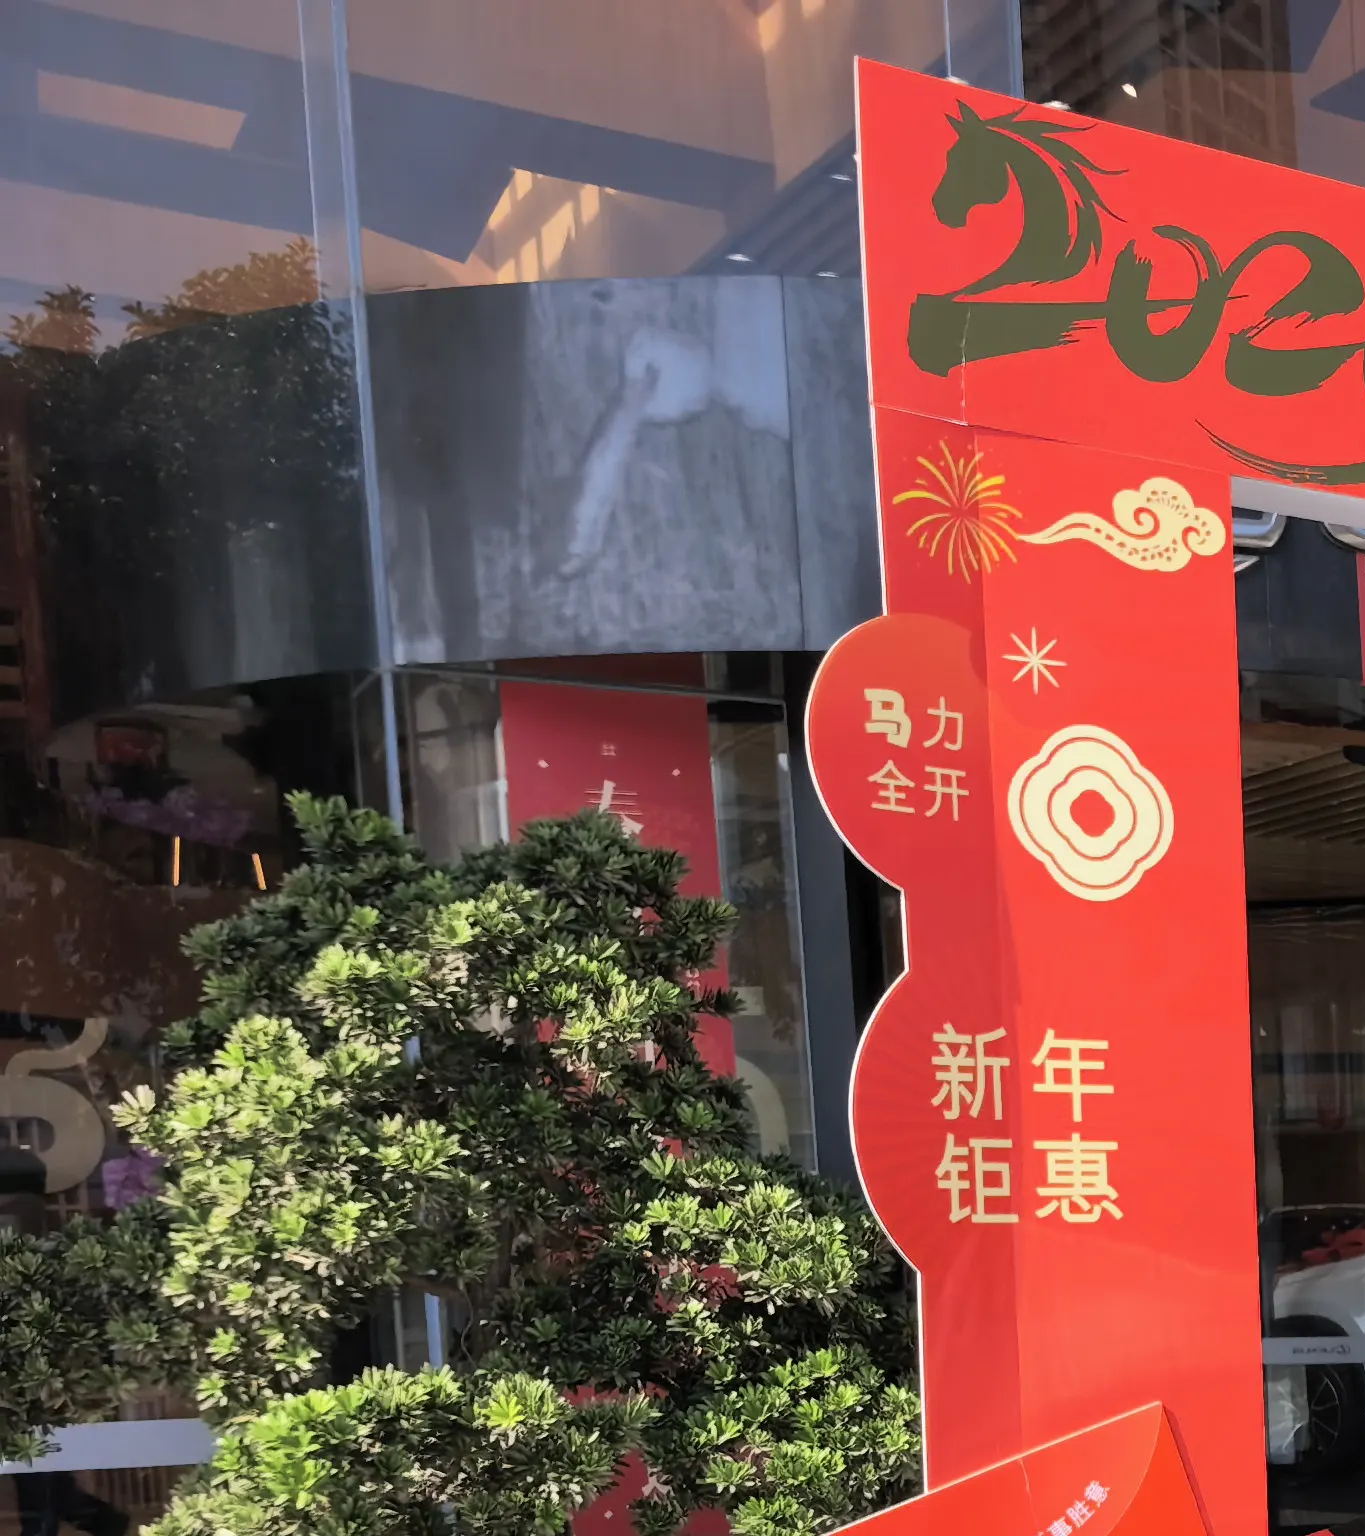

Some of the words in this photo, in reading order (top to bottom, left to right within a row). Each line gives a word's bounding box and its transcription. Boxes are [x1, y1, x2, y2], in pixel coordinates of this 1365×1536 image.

[863, 688, 964, 752] 马力
[867, 759, 970, 822] 全开
[930, 1021, 1115, 1123] 新年
[934, 1131, 1124, 1224] 钜惠
